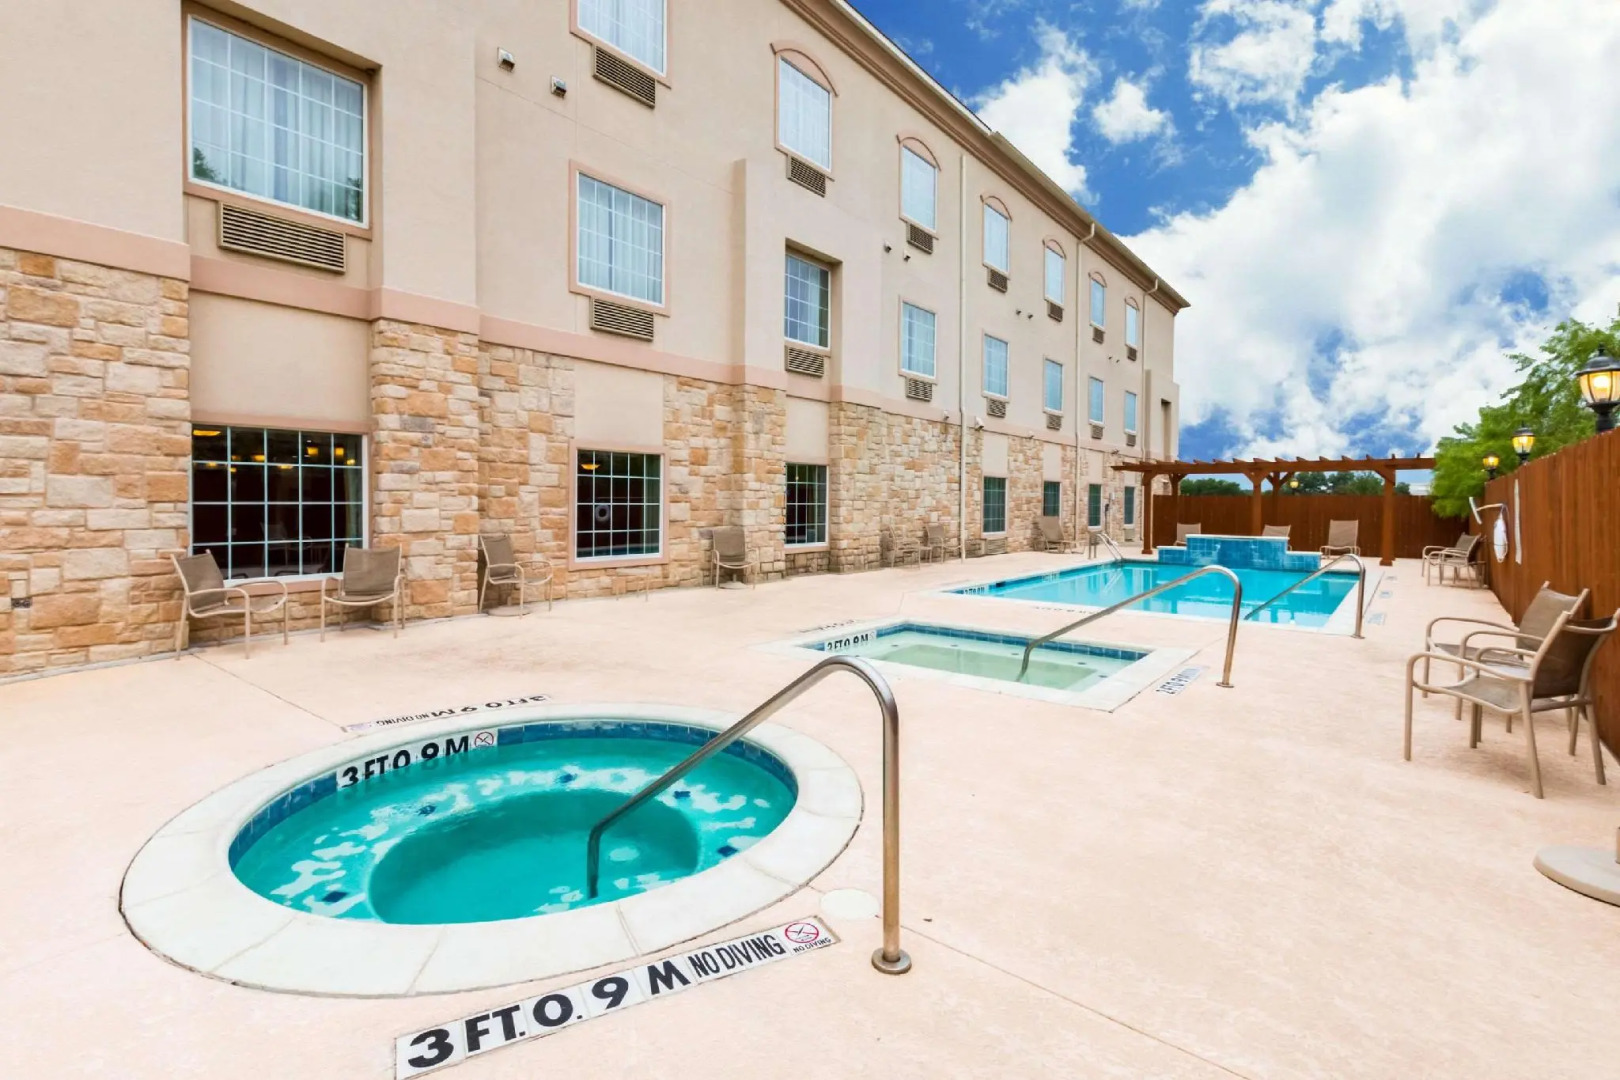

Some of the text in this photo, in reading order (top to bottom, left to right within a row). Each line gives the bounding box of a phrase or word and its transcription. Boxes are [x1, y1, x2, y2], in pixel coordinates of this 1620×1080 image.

[376, 715, 414, 726] DIVING
[445, 735, 469, 756] M
[793, 937, 832, 953] NO DIVING
[408, 1028, 454, 1068] 3
[646, 960, 691, 996] M
[688, 949, 720, 978] NO
[721, 933, 786, 970] DIVING
